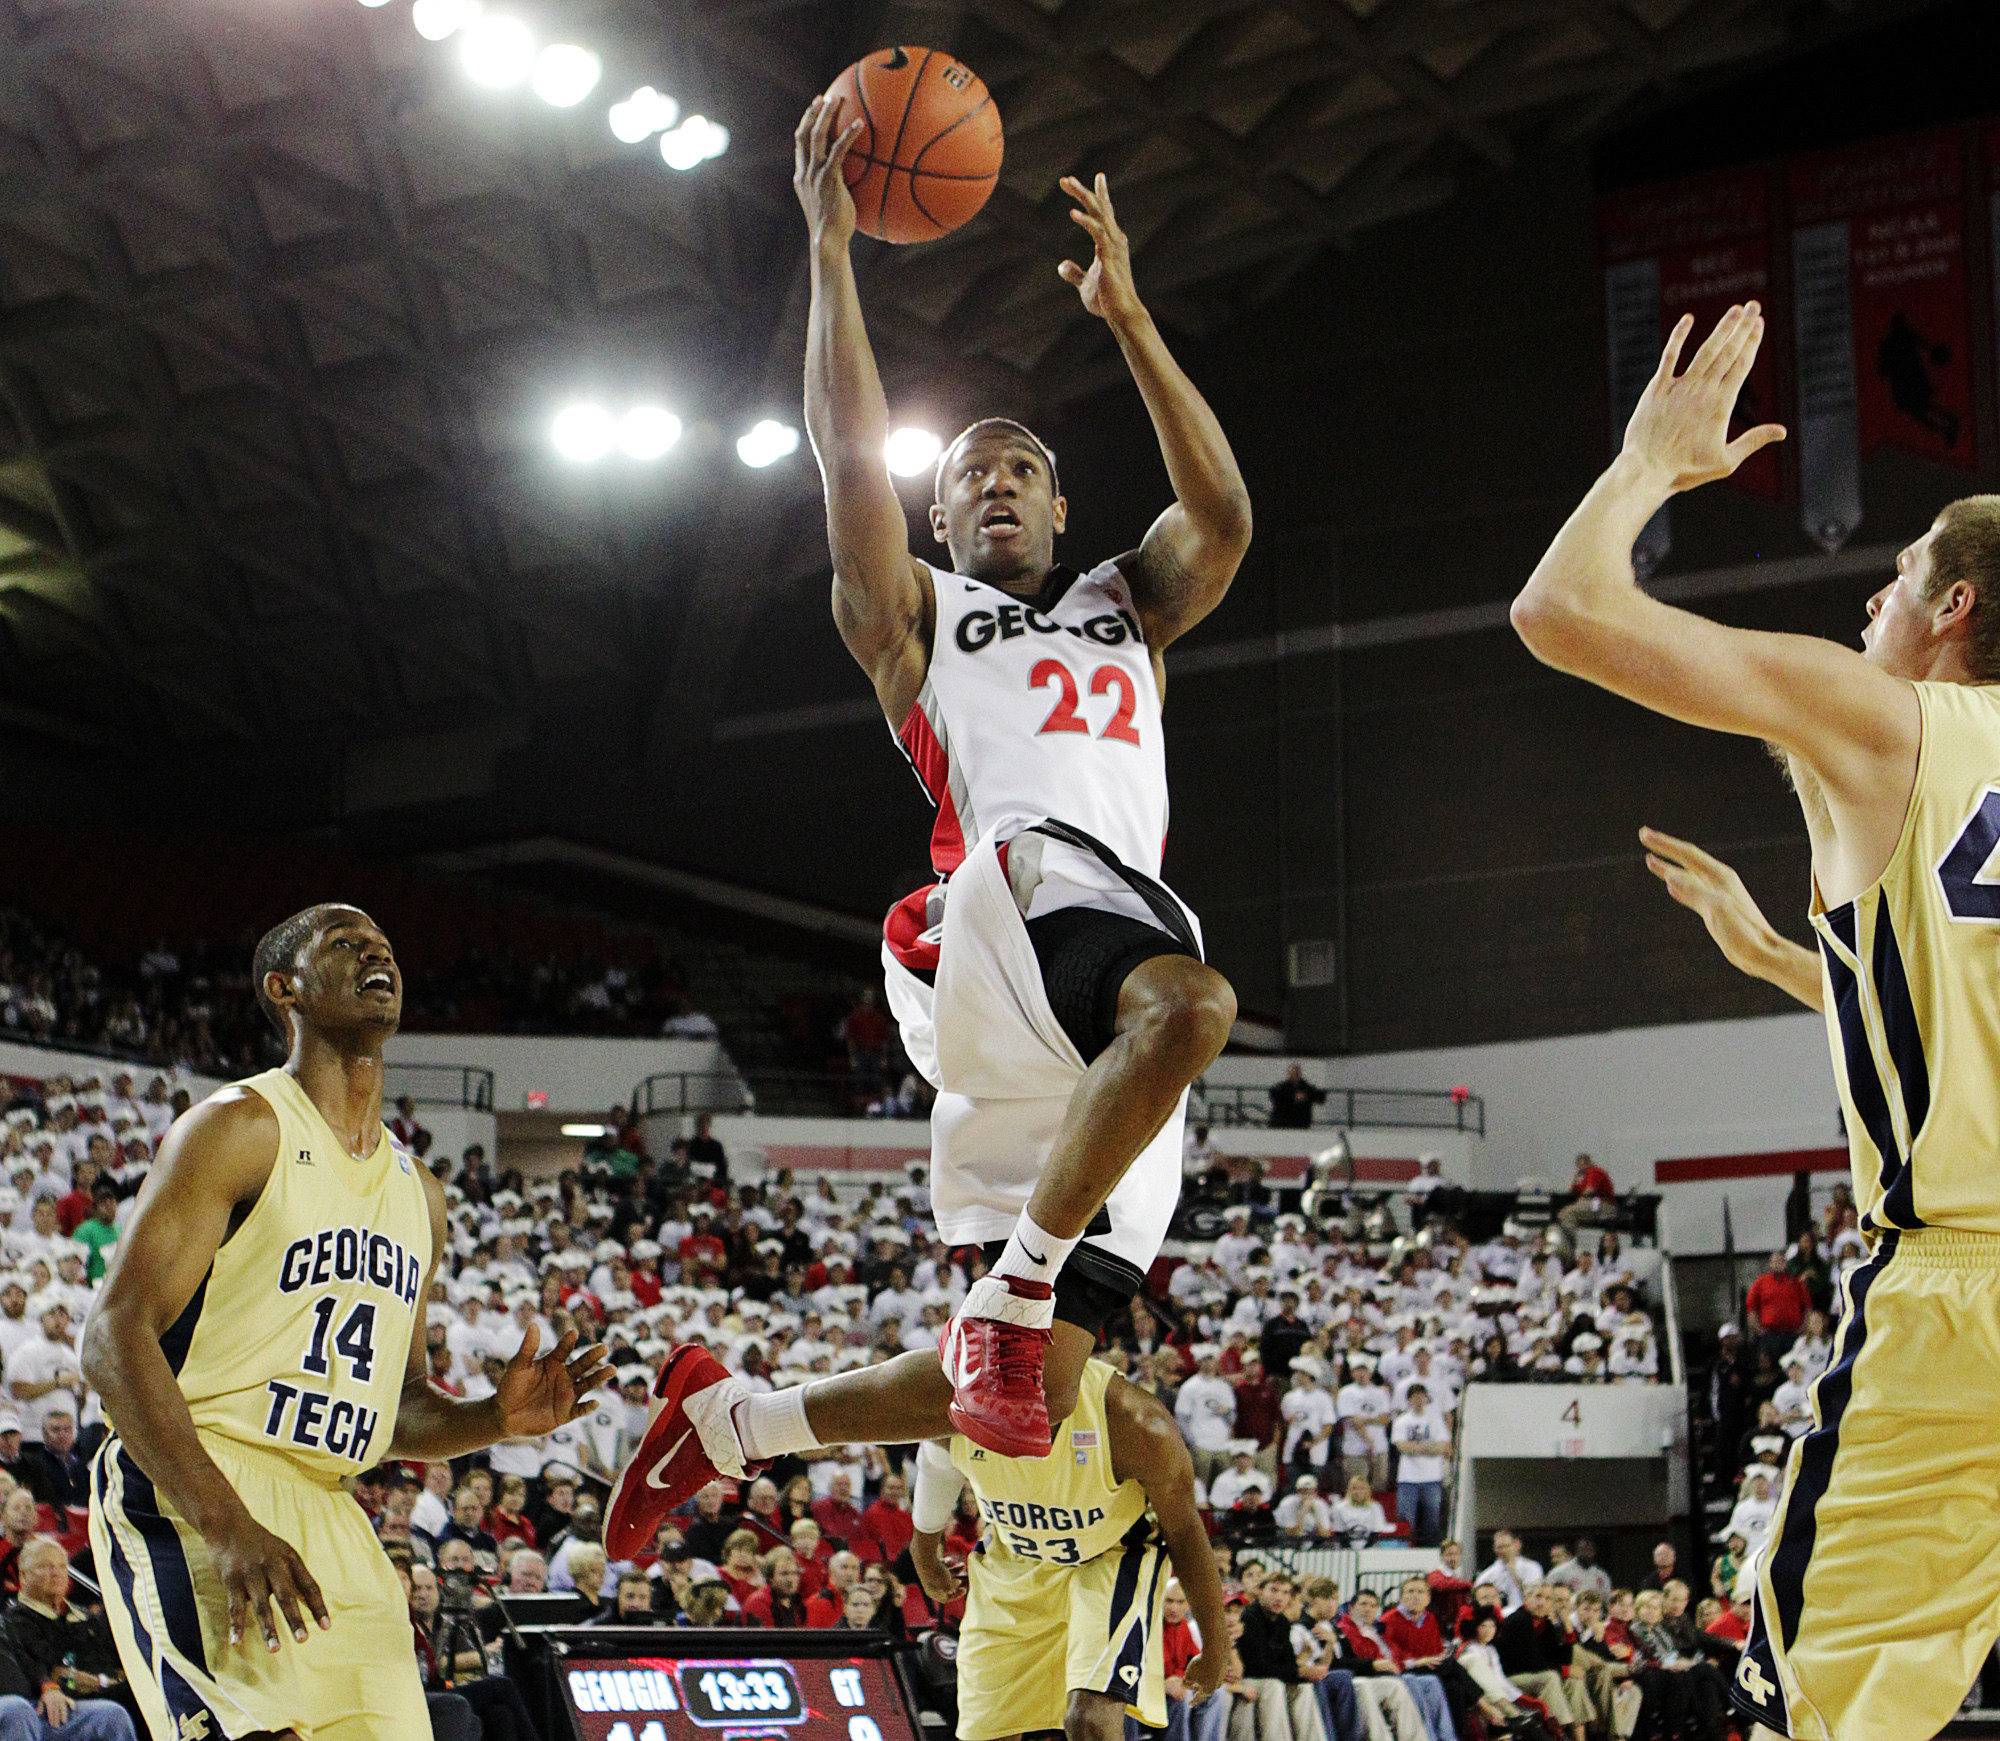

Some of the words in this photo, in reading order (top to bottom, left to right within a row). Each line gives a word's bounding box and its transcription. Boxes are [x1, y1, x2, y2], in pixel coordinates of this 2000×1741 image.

[1027, 658, 1141, 748] 22
[300, 1292, 378, 1385] 14
[264, 1380, 378, 1463] TECH
[1560, 1399, 1582, 1428] 4
[1009, 1532, 1081, 1564] 23
[567, 1669, 679, 1712] GEORGIA
[698, 1671, 792, 1712] 13:33
